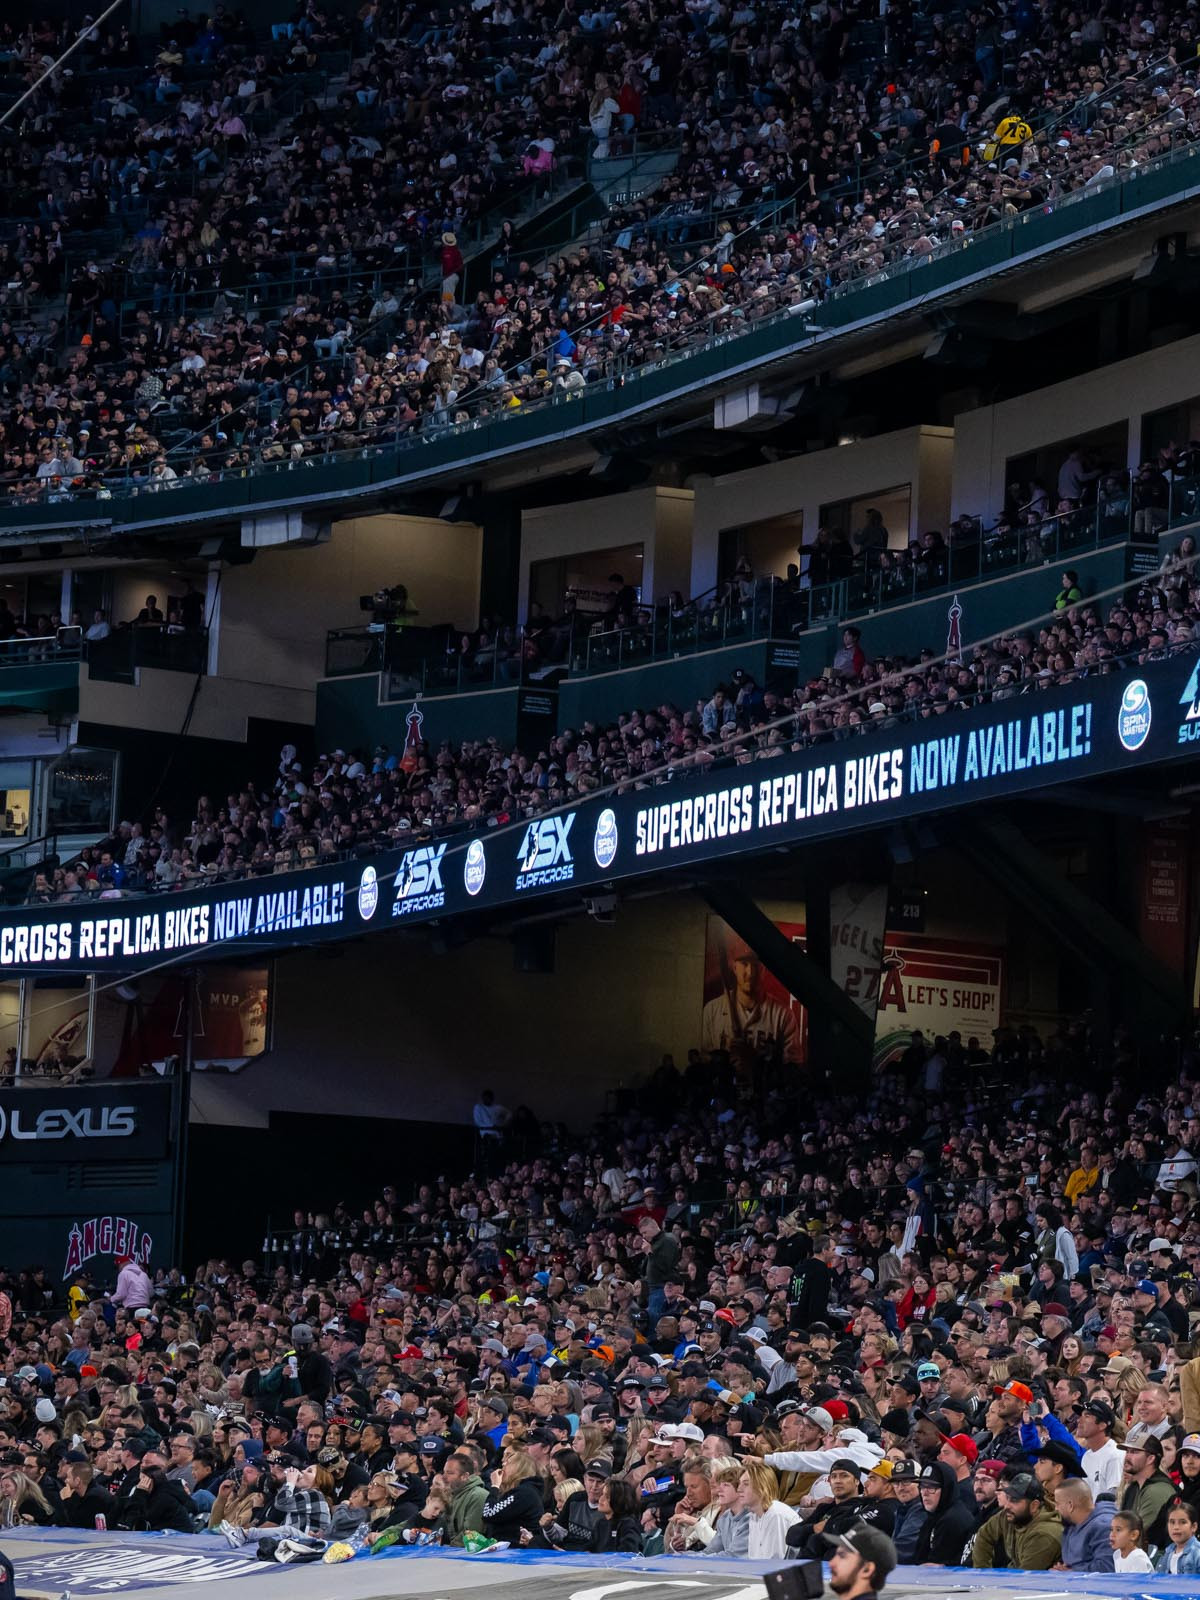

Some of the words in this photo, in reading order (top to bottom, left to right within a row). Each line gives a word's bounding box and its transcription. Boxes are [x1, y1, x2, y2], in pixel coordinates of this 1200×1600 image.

[1122, 714, 1146, 728] SPIN
[635, 784, 753, 855] SUPERCROSS
[758, 763, 839, 828] REPLICA
[843, 748, 904, 809] BIKES
[909, 735, 960, 794] NOW
[964, 703, 1093, 782] AVAILABLE!
[597, 838, 615, 848] SPIN
[515, 863, 575, 890] SUPERCROSS
[392, 891, 445, 917] SUPERCROSS
[0, 922, 72, 965] CROSS
[79, 913, 161, 959] REPLICA
[164, 905, 210, 949] BIKES
[213, 897, 253, 941] NOW
[255, 882, 345, 935] AVAILABLE!
[209, 992, 240, 1006] MVP
[907, 984, 949, 1007] LET'S
[952, 989, 995, 1012] SHOP!
[10, 1105, 137, 1141] LEXUS
[62, 1215, 153, 1283] ANGELS
